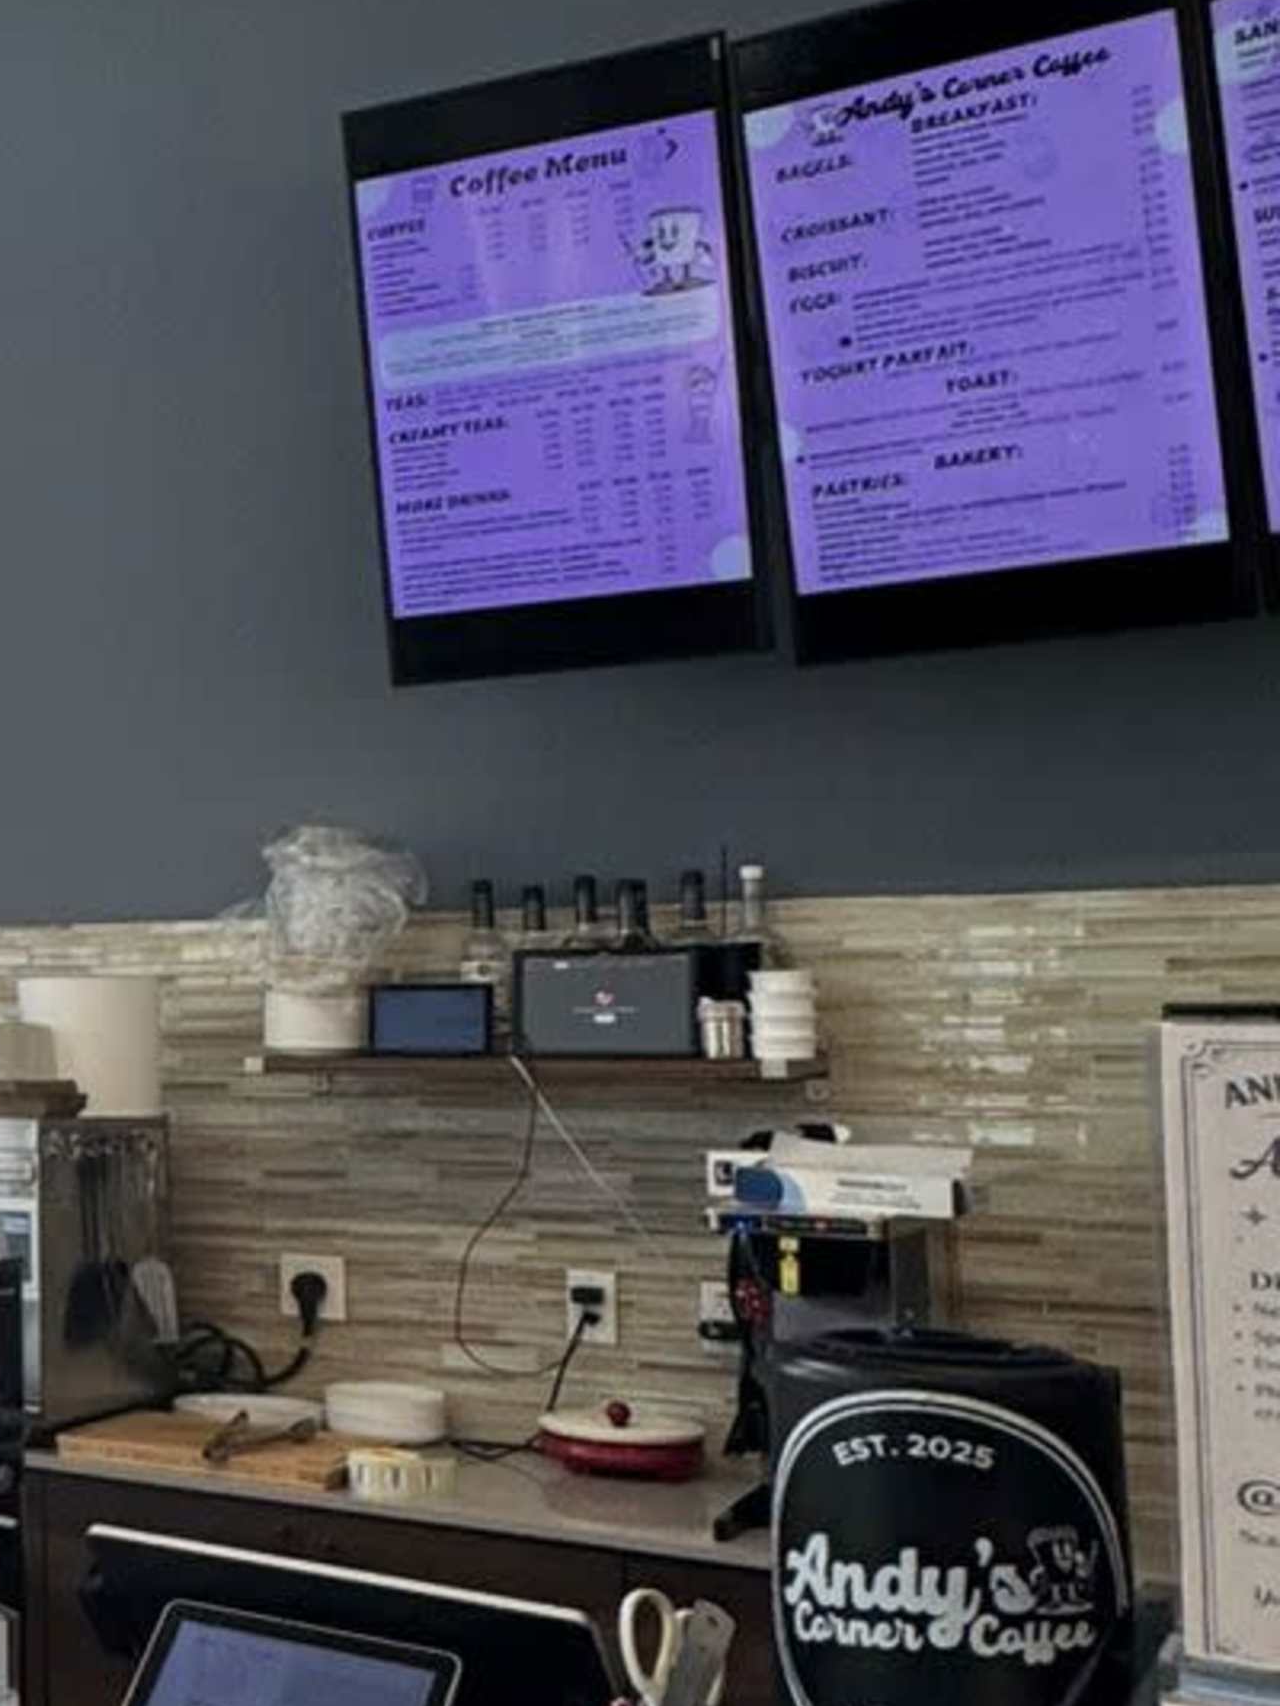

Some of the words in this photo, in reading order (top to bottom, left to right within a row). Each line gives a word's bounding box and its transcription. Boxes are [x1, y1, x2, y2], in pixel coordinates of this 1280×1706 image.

[837, 82, 937, 127] Andy's
[1032, 46, 1113, 79] Coffee
[449, 162, 539, 198] Coffee
[544, 147, 629, 180] Menu
[832, 1434, 899, 1466] EST.
[907, 1434, 995, 1471] 2025
[783, 1531, 1039, 1650] Andy's
[794, 1600, 925, 1653] Corner
[968, 1613, 1096, 1666] Coffee
